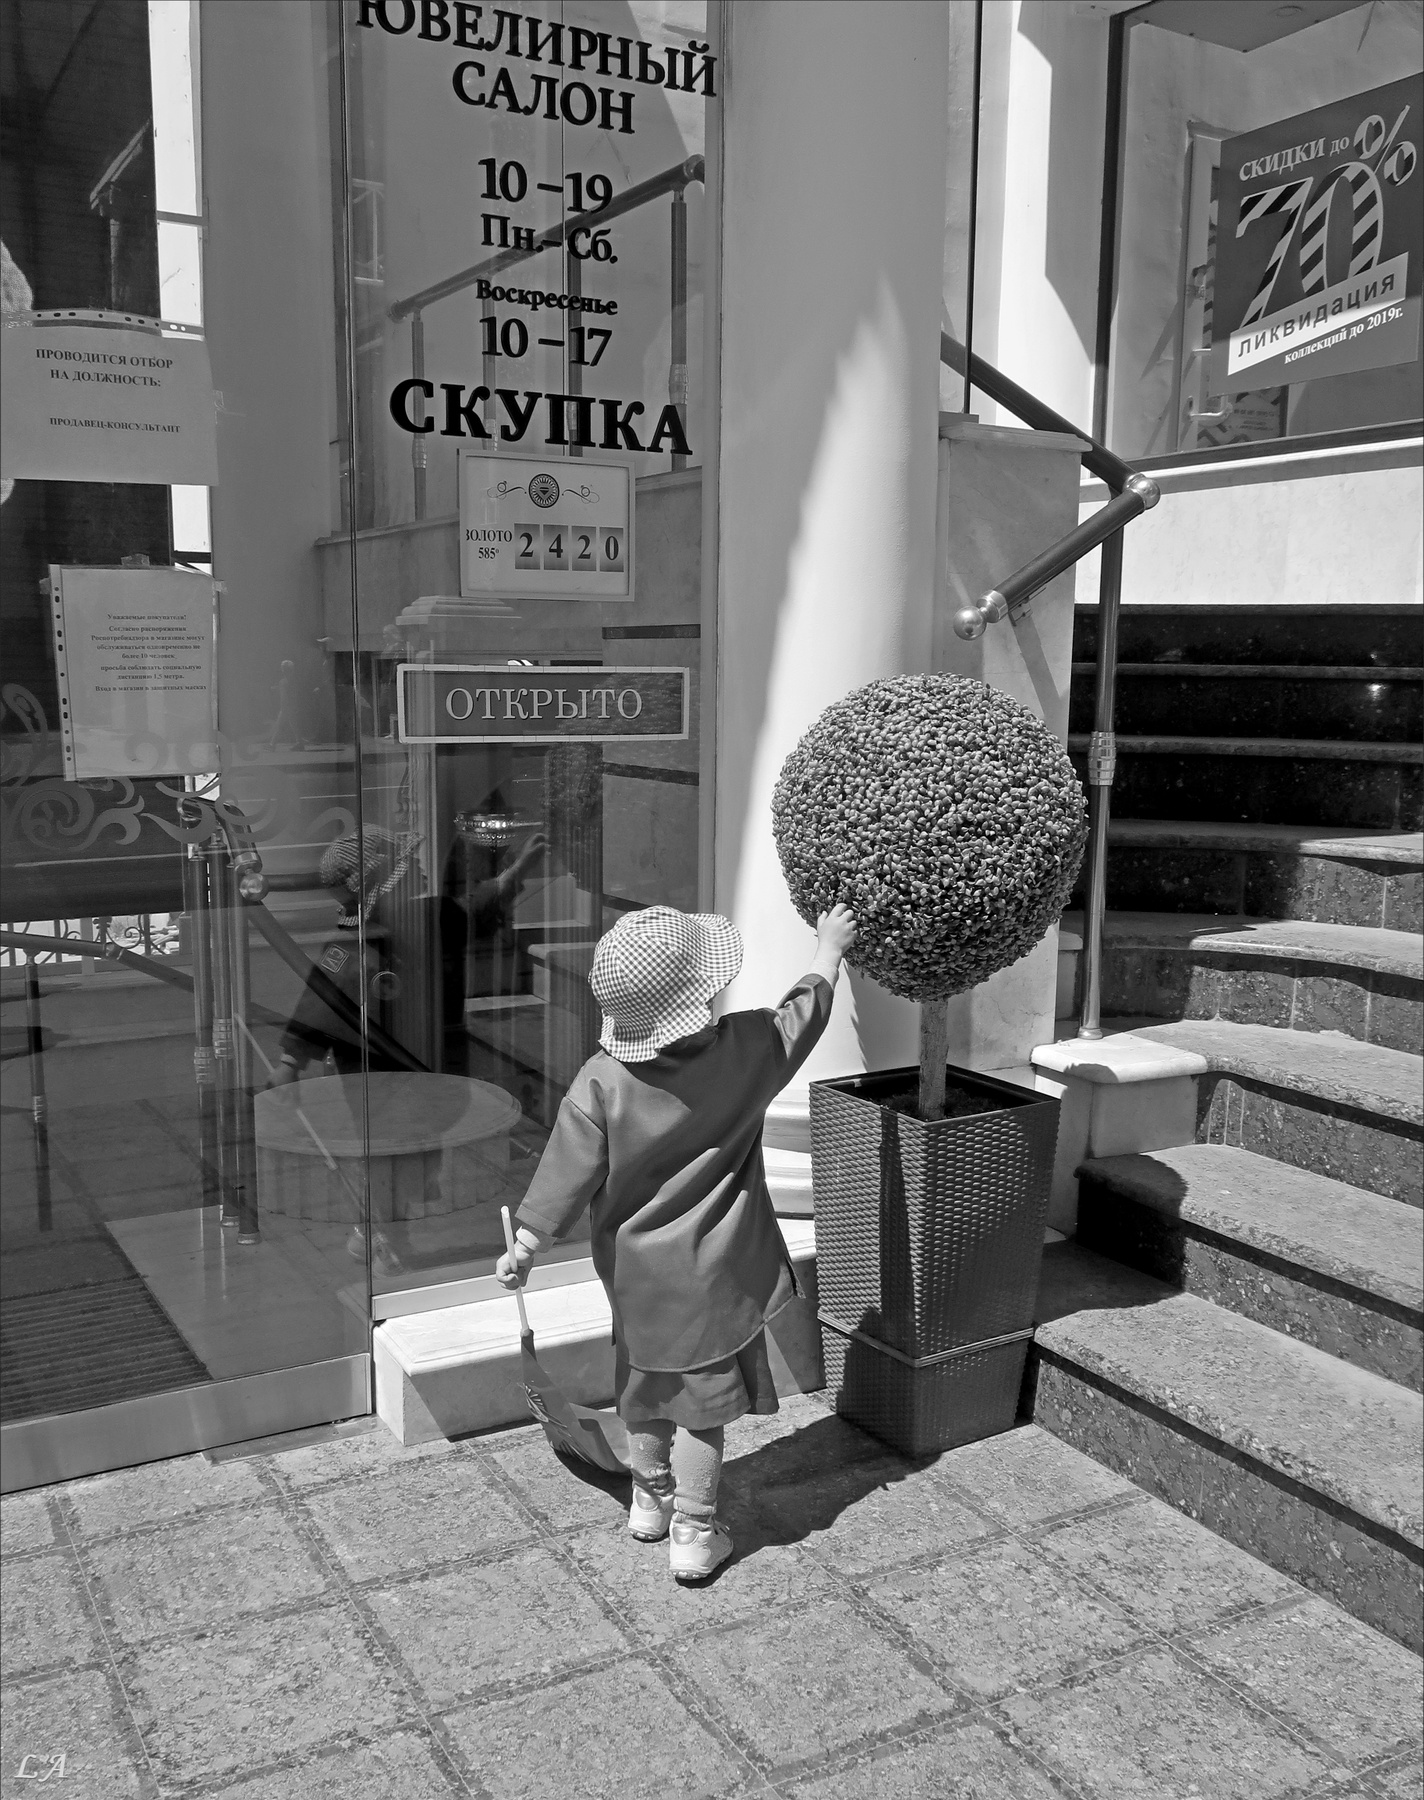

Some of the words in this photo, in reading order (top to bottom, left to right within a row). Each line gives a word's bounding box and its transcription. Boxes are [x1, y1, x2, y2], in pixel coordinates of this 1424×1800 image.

[356, 0, 718, 98] ЮВЕЛИРНЫЙ
[452, 61, 636, 135] САЛОН
[1239, 137, 1327, 182] СКИДКИ
[1330, 136, 1350, 157] до
[476, 279, 619, 316] Воскресенье
[1284, 327, 1348, 365] коллекций
[1349, 322, 1365, 341] до
[1366, 305, 1404, 332] 2019г.
[36, 349, 127, 366] ПРОВОДИТСЯ
[129, 356, 173, 370] ОТБОР
[50, 369, 69, 380] НА
[72, 370, 162, 388] ДОЛЖНОСТЬ:
[49, 417, 181, 434] ПРОДАВЕЦ-КОНСУЛЬТАНТ
[389, 378, 694, 456] СКУПКА
[101, 664, 126, 672] просьба
[445, 687, 643, 721] ОТКРЫТО
